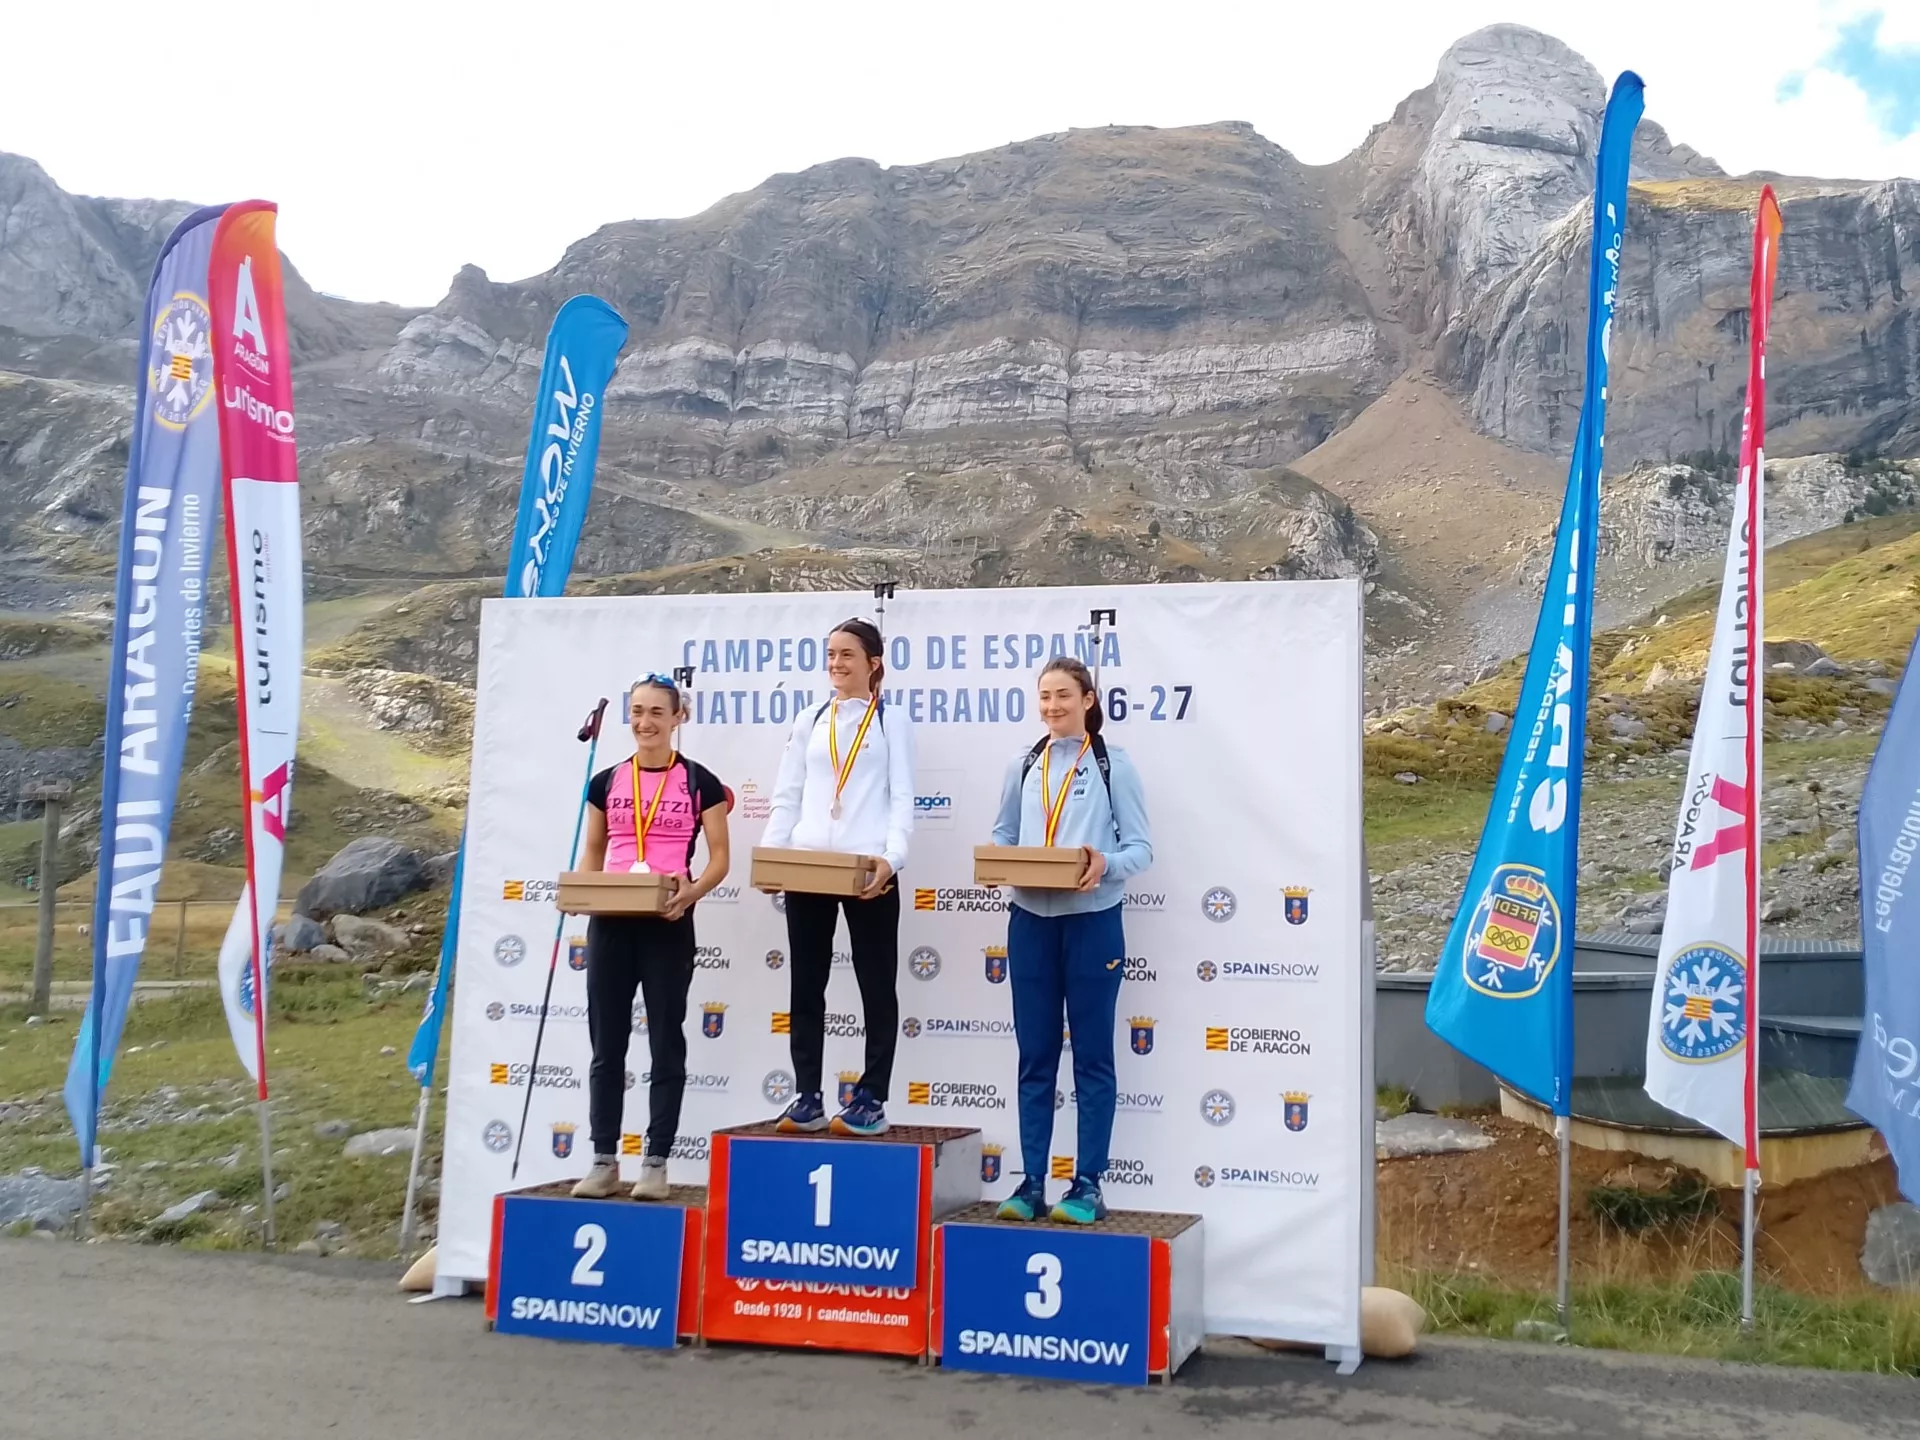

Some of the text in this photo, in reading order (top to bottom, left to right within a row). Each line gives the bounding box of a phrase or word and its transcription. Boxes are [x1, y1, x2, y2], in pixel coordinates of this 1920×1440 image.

[563, 392, 595, 478] INVIERNO
[179, 493, 201, 570] Invierno
[179, 578, 201, 601] de
[251, 529, 272, 707] turismo
[683, 636, 909, 673] CAMPEOO
[927, 635, 966, 669] DE
[913, 791, 951, 811] agón
[106, 799, 162, 959] FADI
[525, 891, 541, 901] DE
[937, 888, 1002, 900] GOBIERNO
[937, 900, 1011, 912] DE ARAGON
[1222, 961, 1319, 976] SPAINSNOW
[1230, 1027, 1301, 1042] GOBIERNO
[1230, 1040, 1311, 1055] DE ARAGON
[510, 1075, 525, 1086] DE
[931, 1082, 997, 1096] GOBIERNO
[931, 1095, 1006, 1109] DE ARAGON
[1221, 1168, 1319, 1185] SPAINSNOW
[808, 1163, 833, 1227] 1
[571, 1223, 608, 1287] 2
[741, 1239, 899, 1271] SPAINSNOW
[1025, 1252, 1063, 1319] 3
[511, 1296, 661, 1330] SPAINSNOW
[734, 1300, 909, 1327] Desde 1928 candanchu.com
[958, 1329, 1130, 1366] SPAINSNOW
